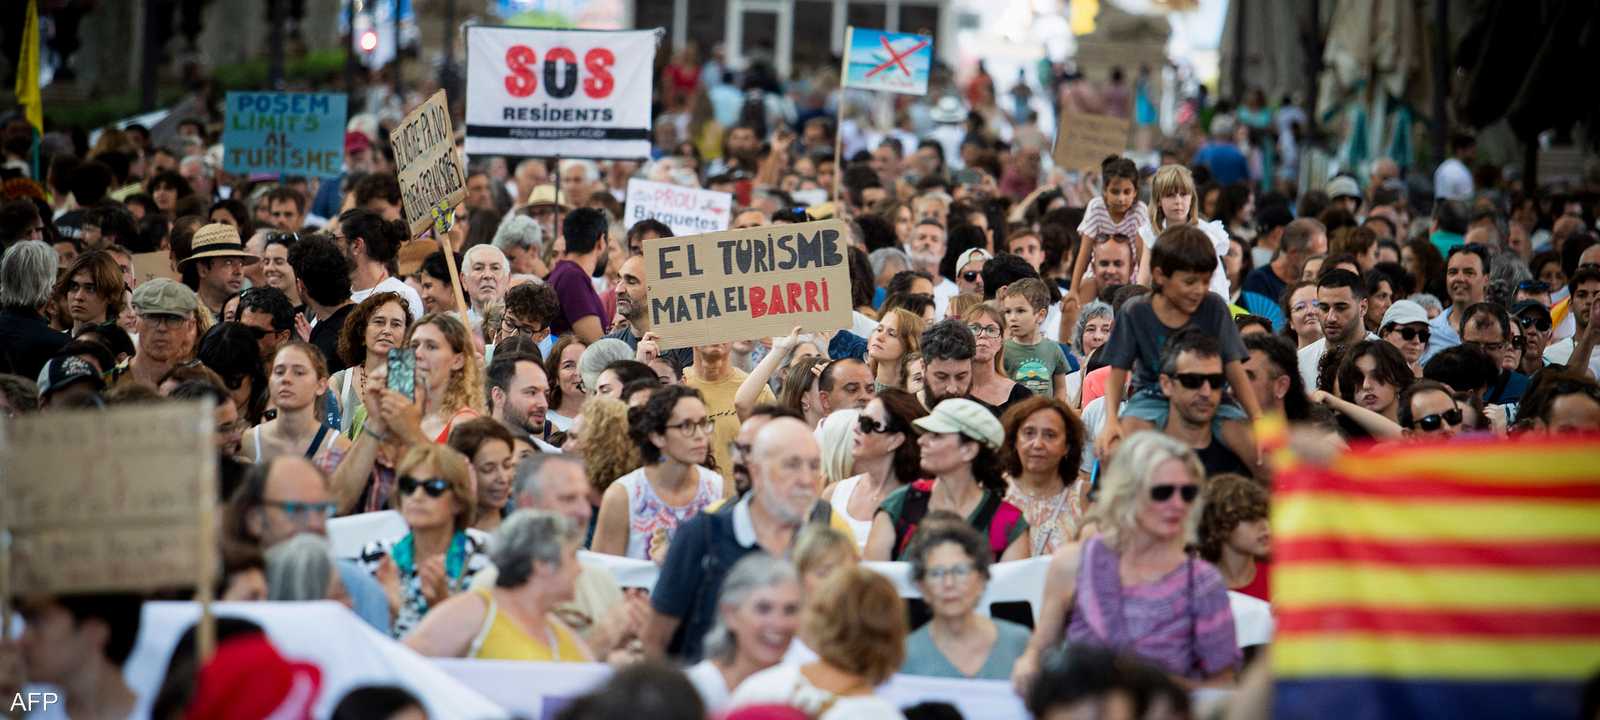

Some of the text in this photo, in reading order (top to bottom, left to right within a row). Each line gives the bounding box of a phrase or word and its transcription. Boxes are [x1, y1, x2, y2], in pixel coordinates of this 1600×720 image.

[504, 44, 616, 99] SOS
[238, 95, 329, 114] POSEM
[655, 188, 697, 208] PROU
[633, 204, 719, 230] Barquetes
[658, 244, 704, 280] EL
[651, 290, 721, 325] MATA
[724, 286, 748, 313] EL
